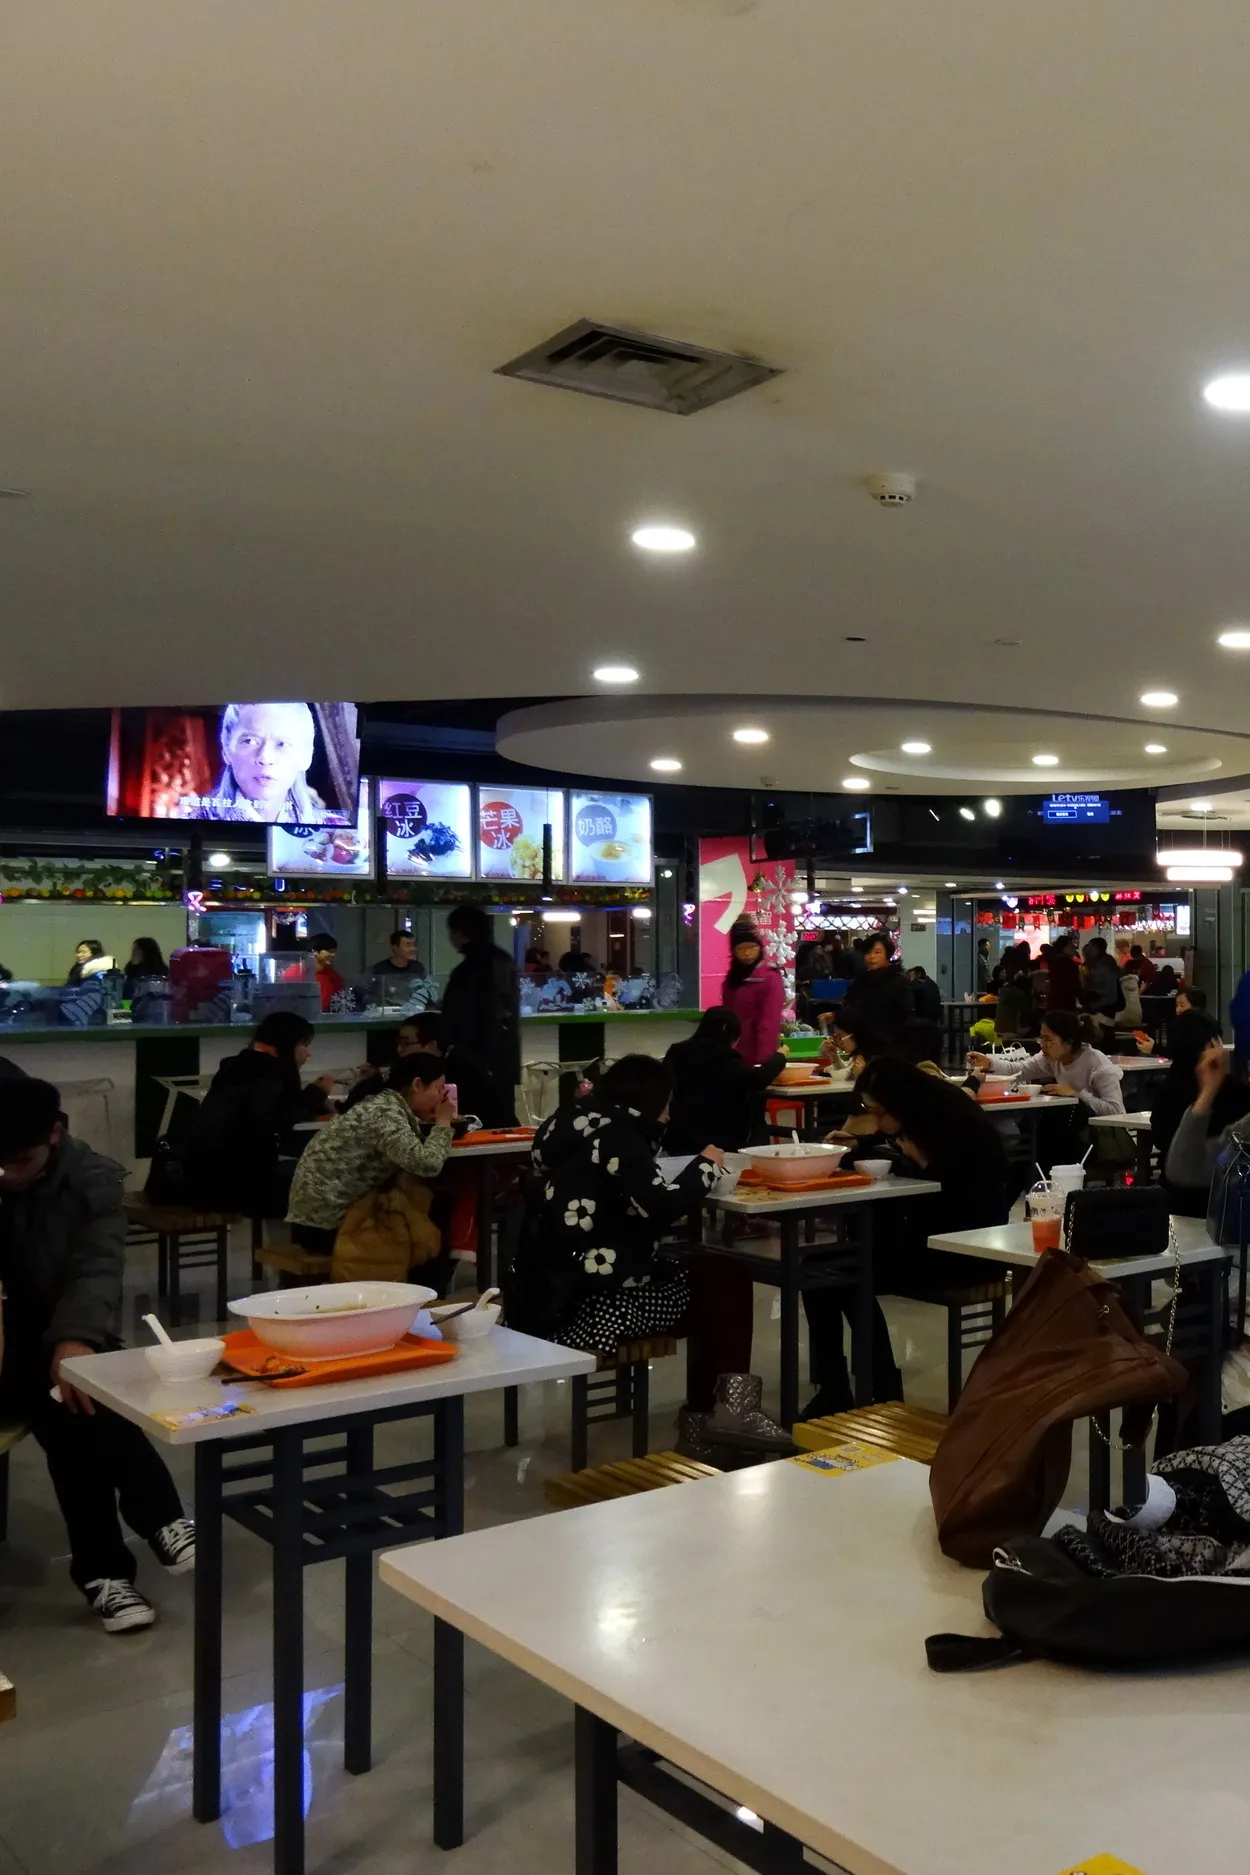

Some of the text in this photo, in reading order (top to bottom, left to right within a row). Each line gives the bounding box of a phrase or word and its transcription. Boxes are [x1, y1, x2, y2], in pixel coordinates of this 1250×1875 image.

[384, 801, 423, 820] 红豆
[480, 808, 520, 831] 芒果
[396, 820, 415, 838] 冰
[577, 816, 613, 837] 奶酪
[491, 830, 513, 850] 冰
